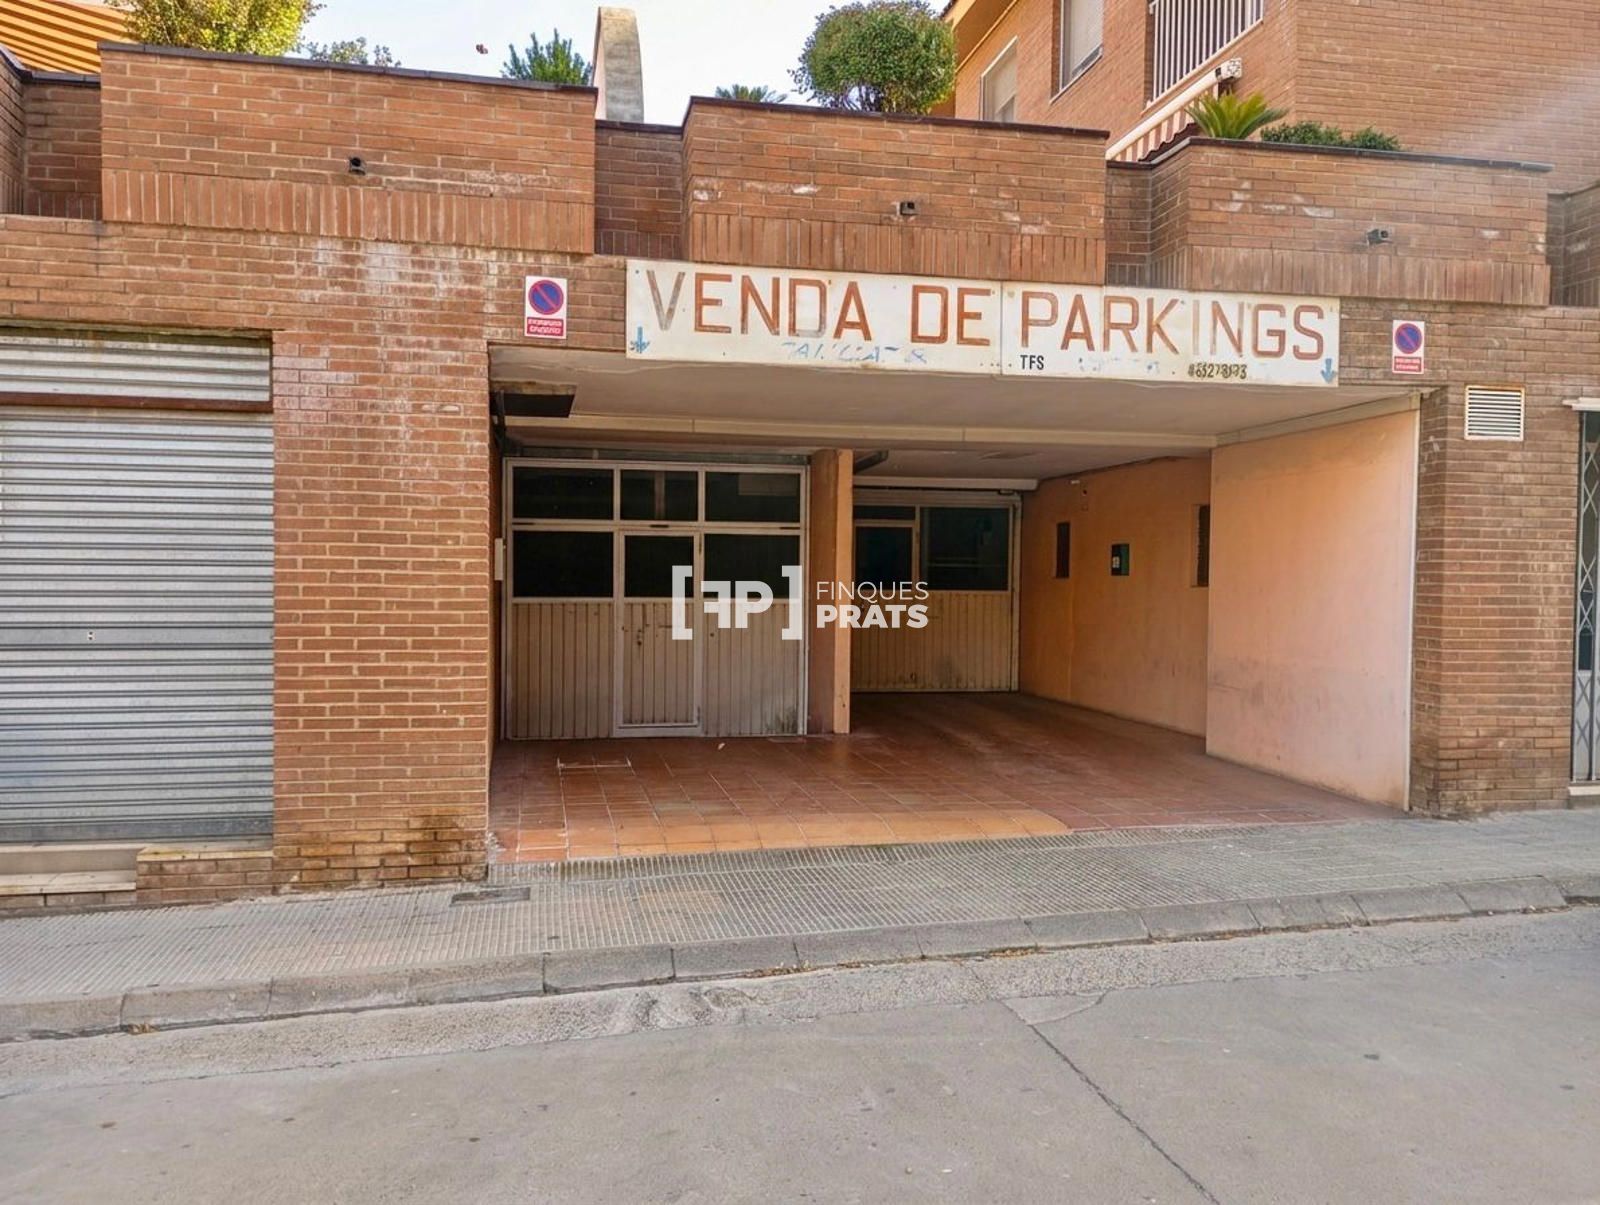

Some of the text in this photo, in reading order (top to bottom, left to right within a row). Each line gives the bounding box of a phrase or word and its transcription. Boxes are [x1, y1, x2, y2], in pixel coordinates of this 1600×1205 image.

[646, 269, 1325, 361] VENDA DE PARKINGS
[1019, 354, 1045, 371] TFS
